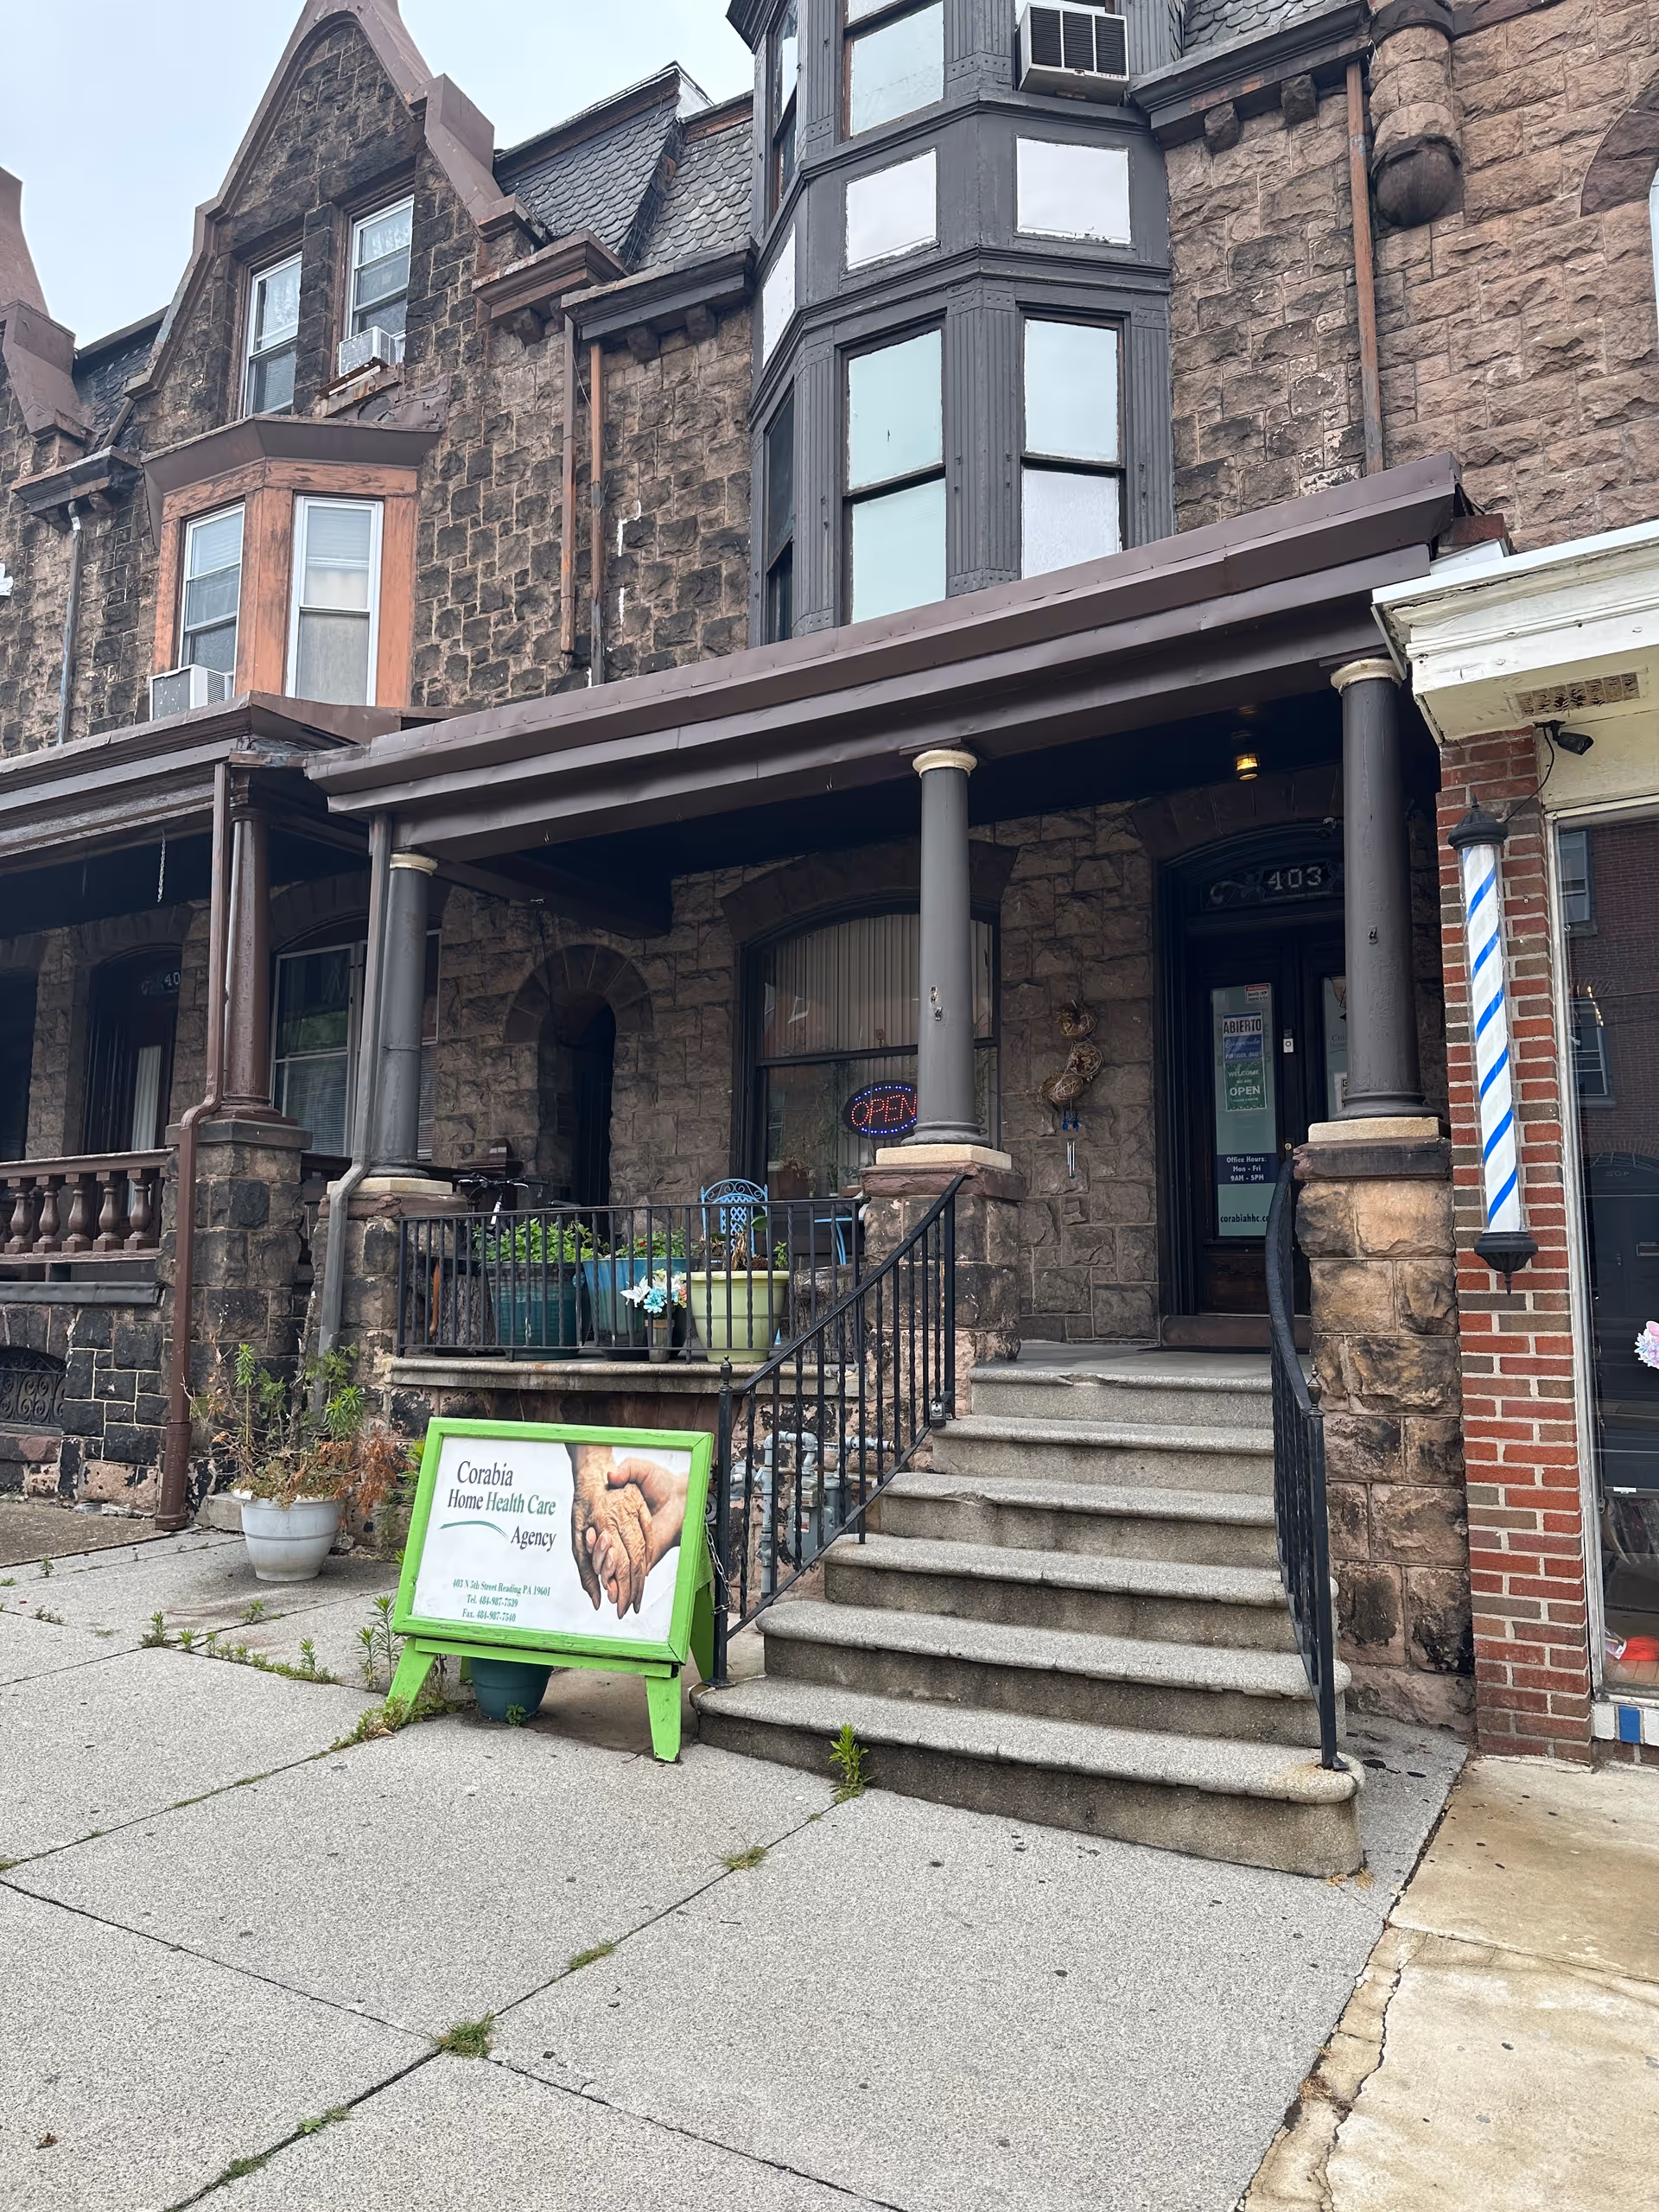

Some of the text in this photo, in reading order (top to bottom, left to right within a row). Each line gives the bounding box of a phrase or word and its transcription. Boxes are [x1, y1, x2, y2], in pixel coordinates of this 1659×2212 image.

[1267, 866, 1322, 891] 403
[164, 971, 181, 987] 40
[1224, 1019, 1262, 1034] ABIERTO
[1228, 1069, 1259, 1077] WELCOME
[1230, 1085, 1261, 1096] OPEN
[851, 1093, 918, 1126] OPEN
[457, 1460, 513, 1486] Corabia
[448, 1489, 556, 1516] Home Health Care
[511, 1525, 556, 1552] Agency
[453, 1579, 550, 1597] 403 N 5th Street Reading PA 19601
[479, 1595, 518, 1607] 484-987-7539
[476, 1610, 517, 1622] 484-987-7540
